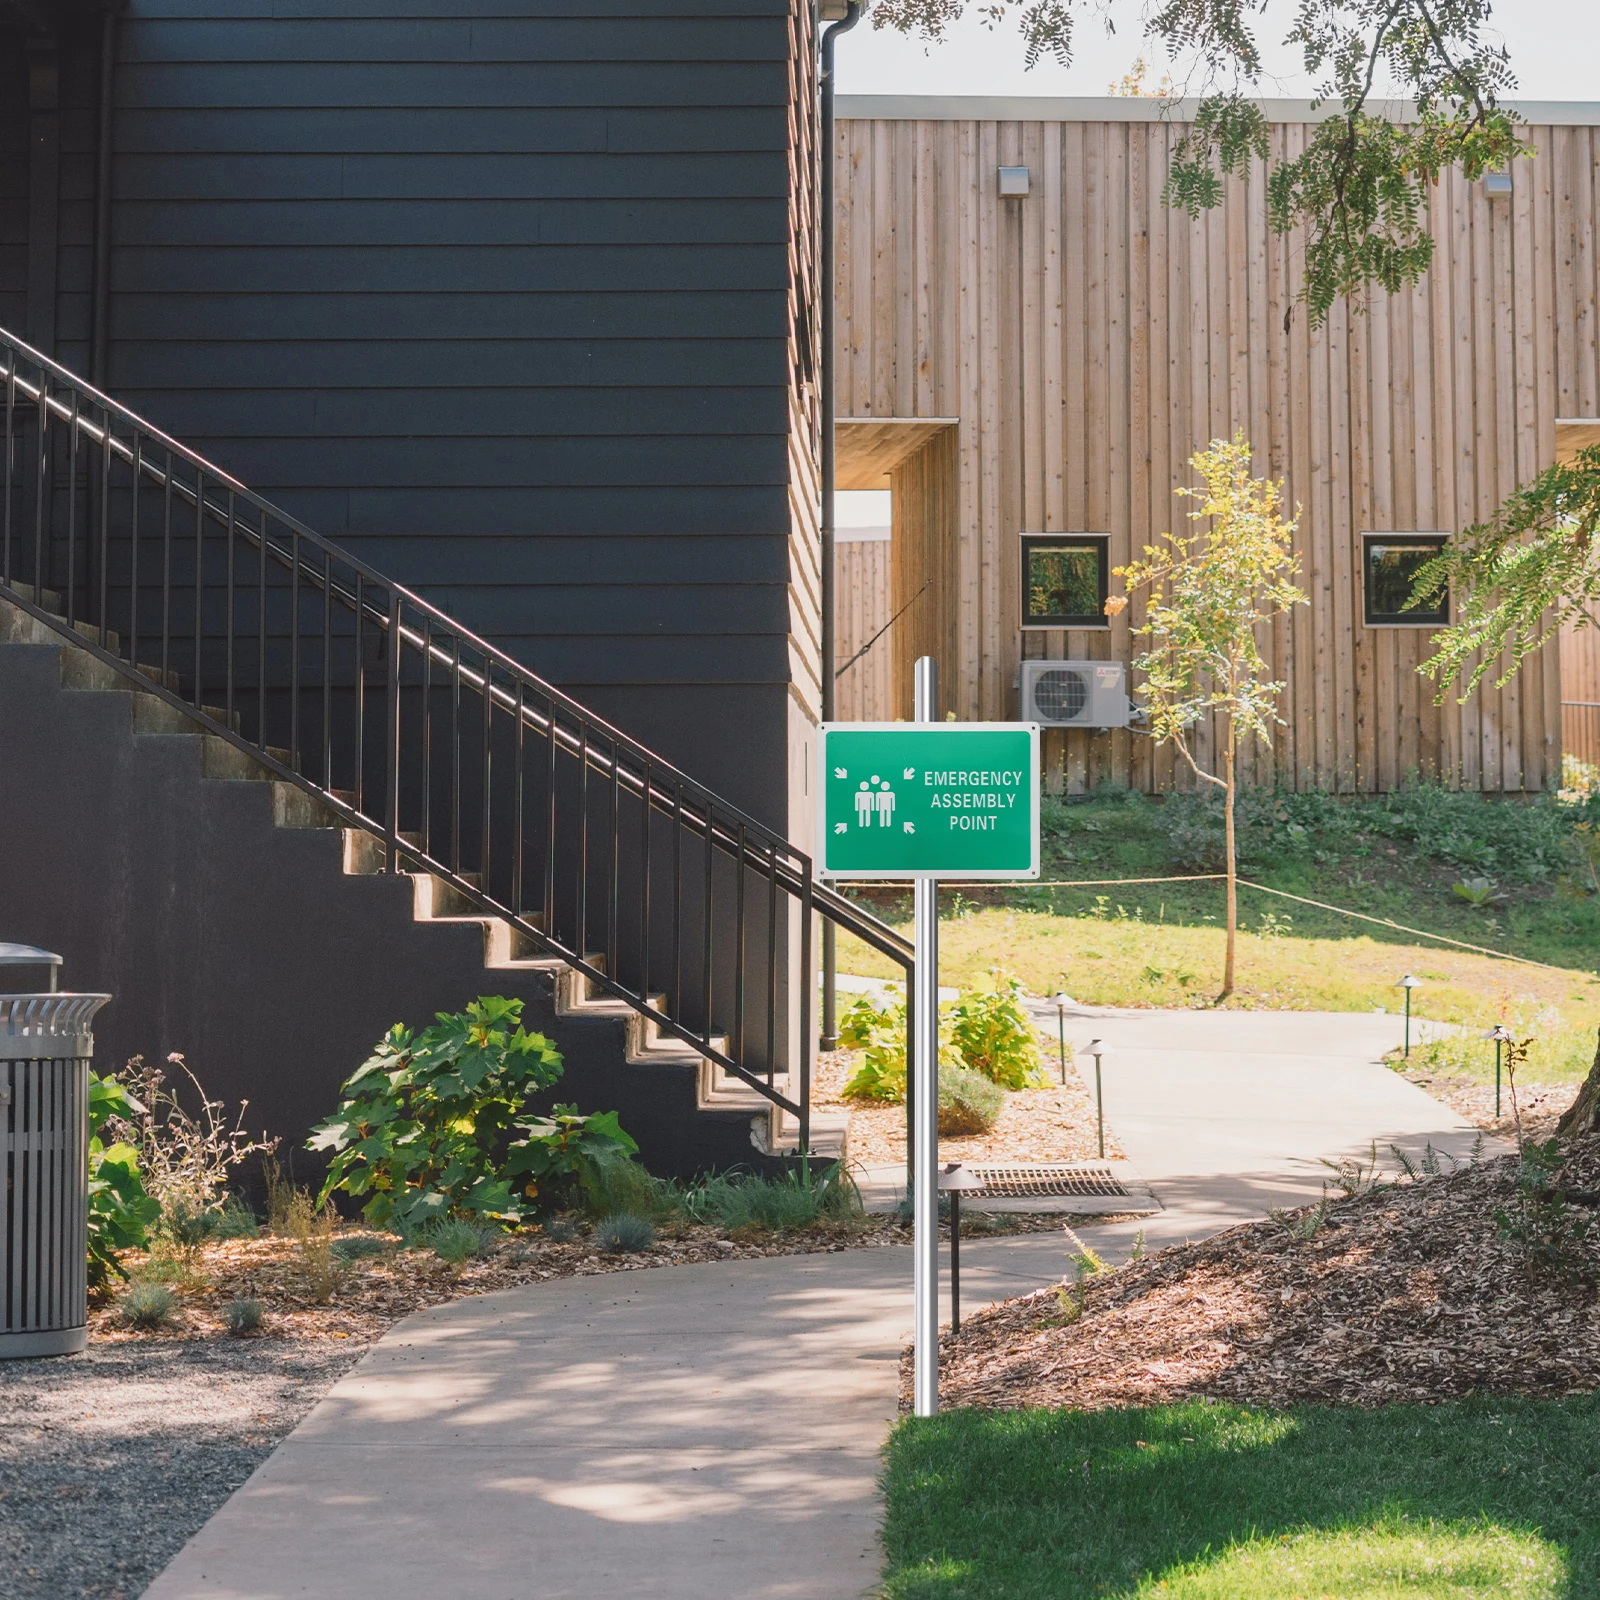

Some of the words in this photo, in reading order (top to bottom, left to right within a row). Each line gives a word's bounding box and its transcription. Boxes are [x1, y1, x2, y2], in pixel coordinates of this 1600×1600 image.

[925, 771, 1022, 785] EMERGENCY
[931, 794, 1015, 808] ASSEMBLY
[950, 816, 997, 830] POINT
